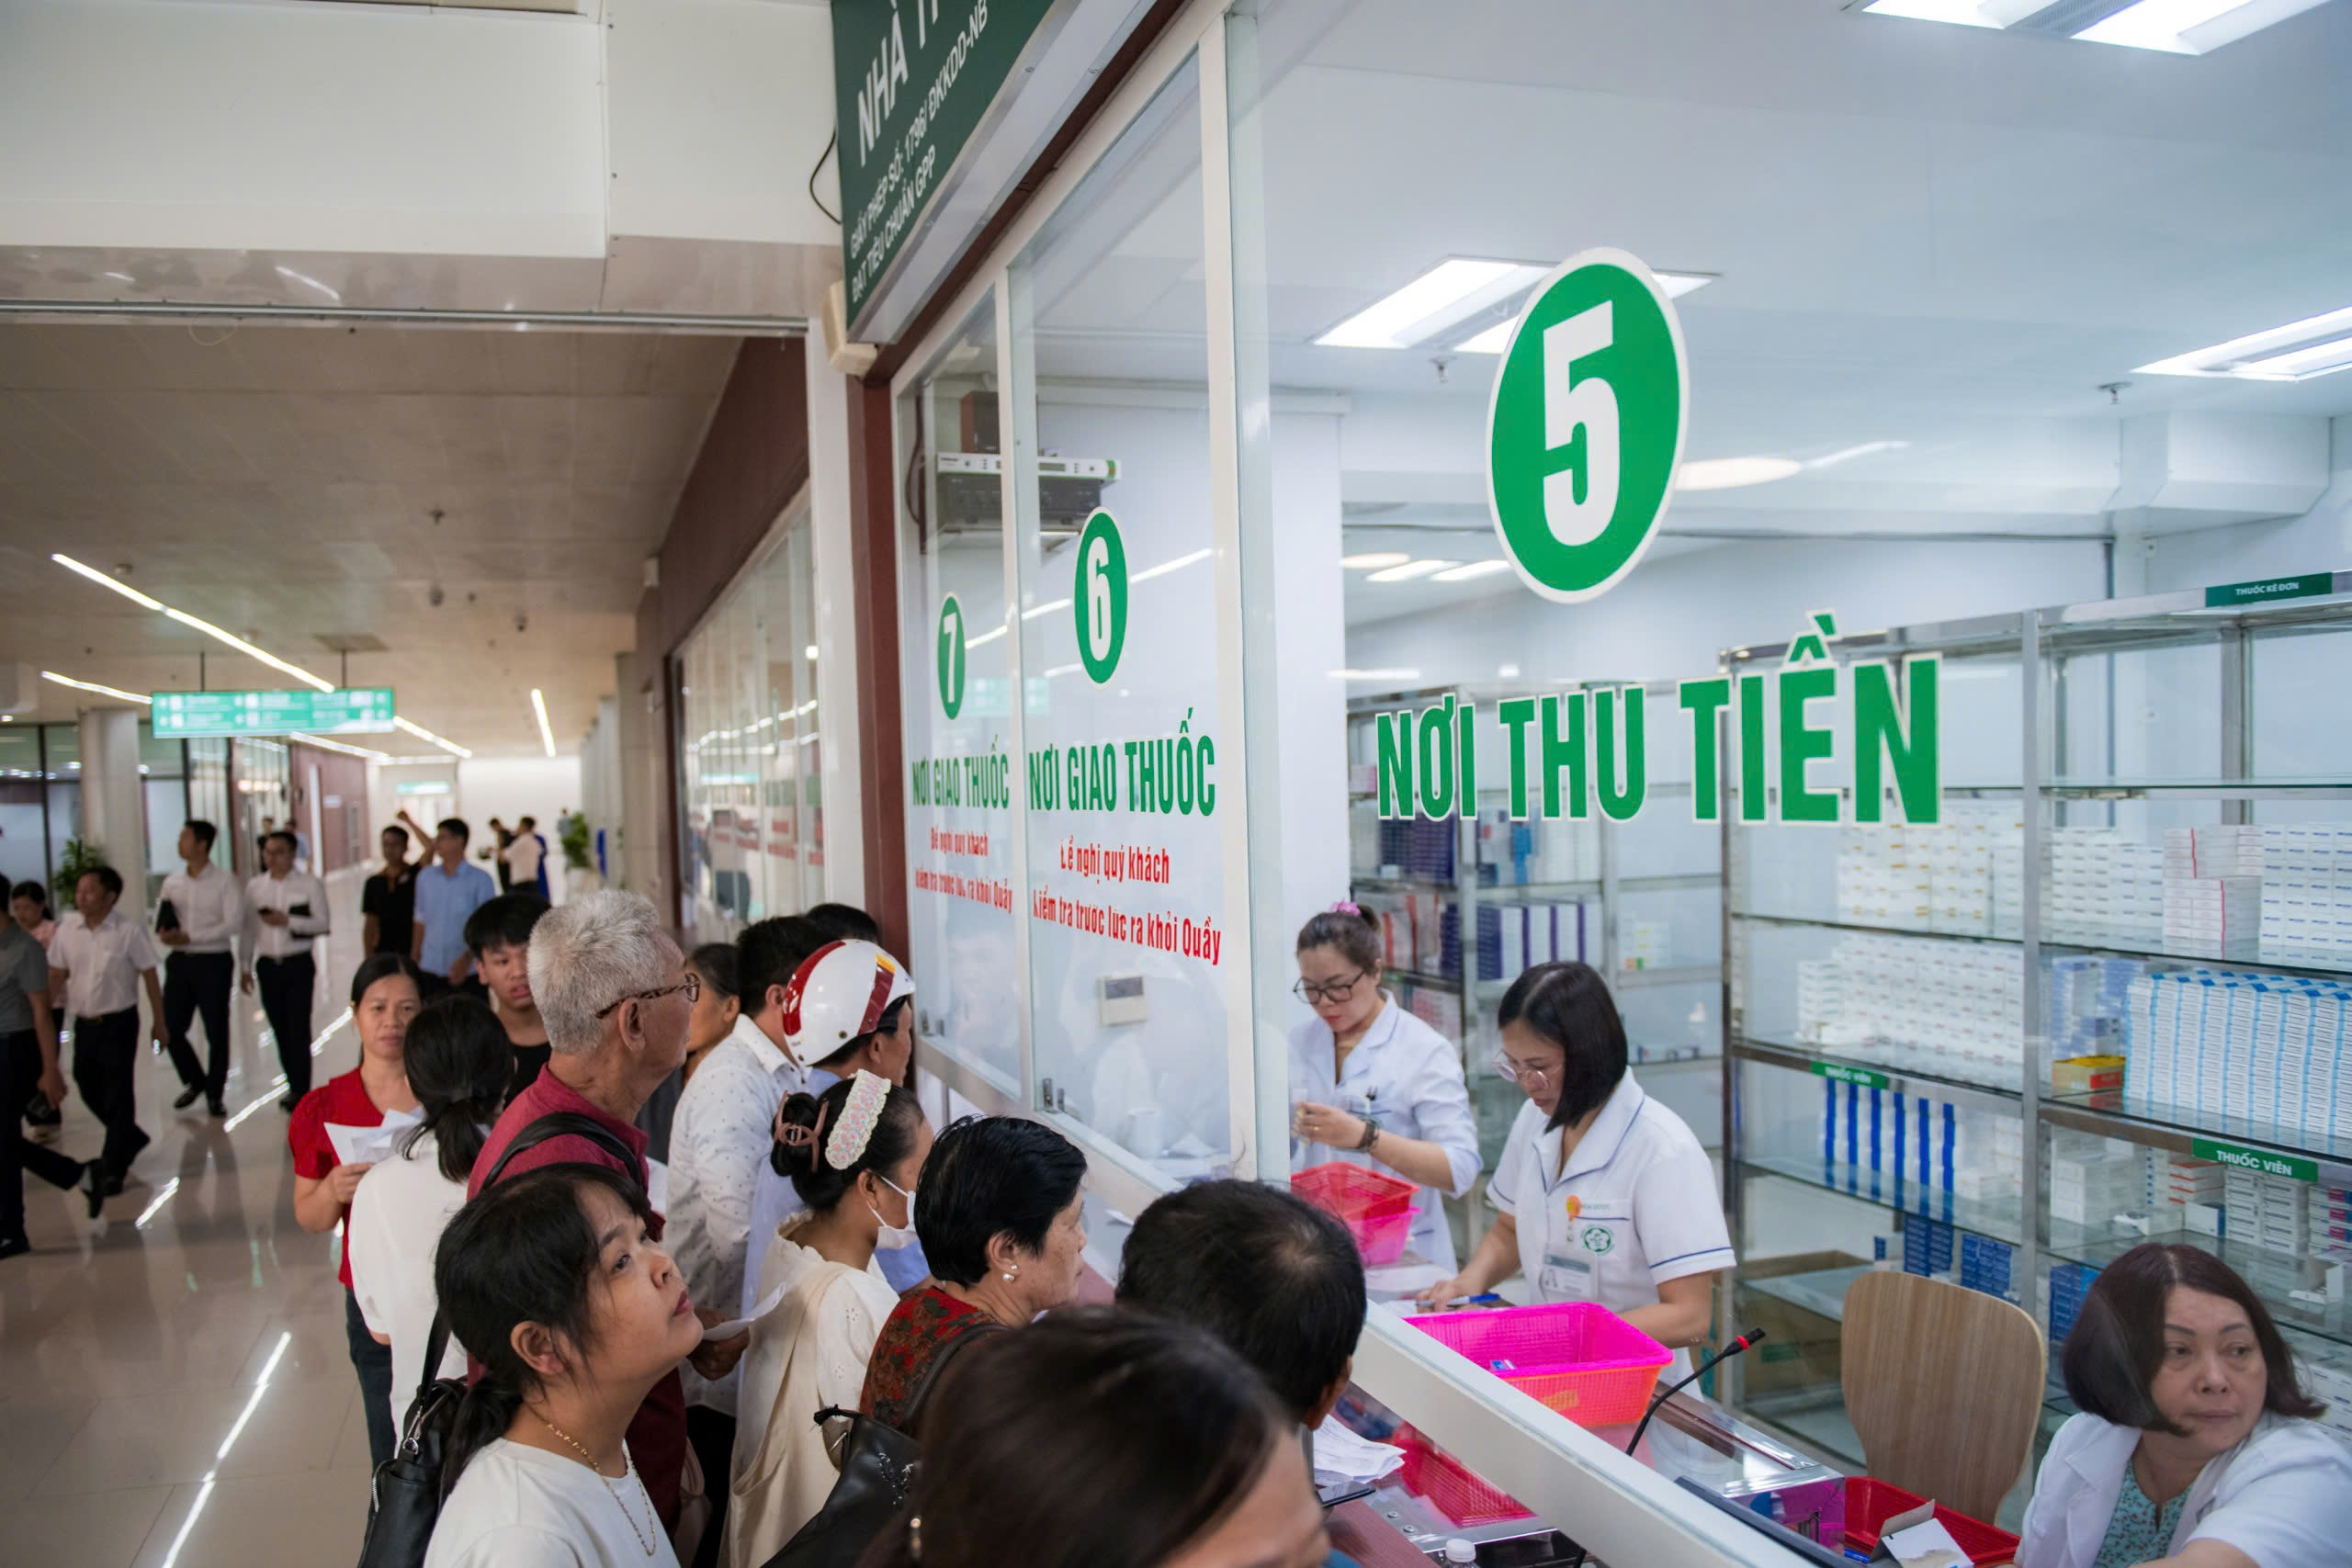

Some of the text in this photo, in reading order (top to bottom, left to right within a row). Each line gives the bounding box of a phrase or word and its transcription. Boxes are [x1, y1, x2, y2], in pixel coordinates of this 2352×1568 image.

[857, 0, 909, 167] NHÀ
[915, 144, 936, 198] GPP
[1544, 299, 1620, 547] 5
[1086, 536, 1112, 661] 6
[943, 611, 957, 704] 7
[1029, 706, 1216, 817] NƠI GIAO THUỐC
[1375, 610, 1941, 828] NƠI THU TIỀN
[912, 733, 1010, 809] NƠI GIAO THUỐC
[1076, 842, 1102, 885] nghị
[1103, 844, 1125, 883] quý
[1128, 845, 1170, 884] khách
[1059, 896, 1073, 928] tra
[1130, 915, 1143, 946] ra
[1148, 910, 1178, 953] khỏi
[1182, 916, 1221, 966] Quầy
[2216, 1149, 2292, 1177] THUỐC VIÊN
